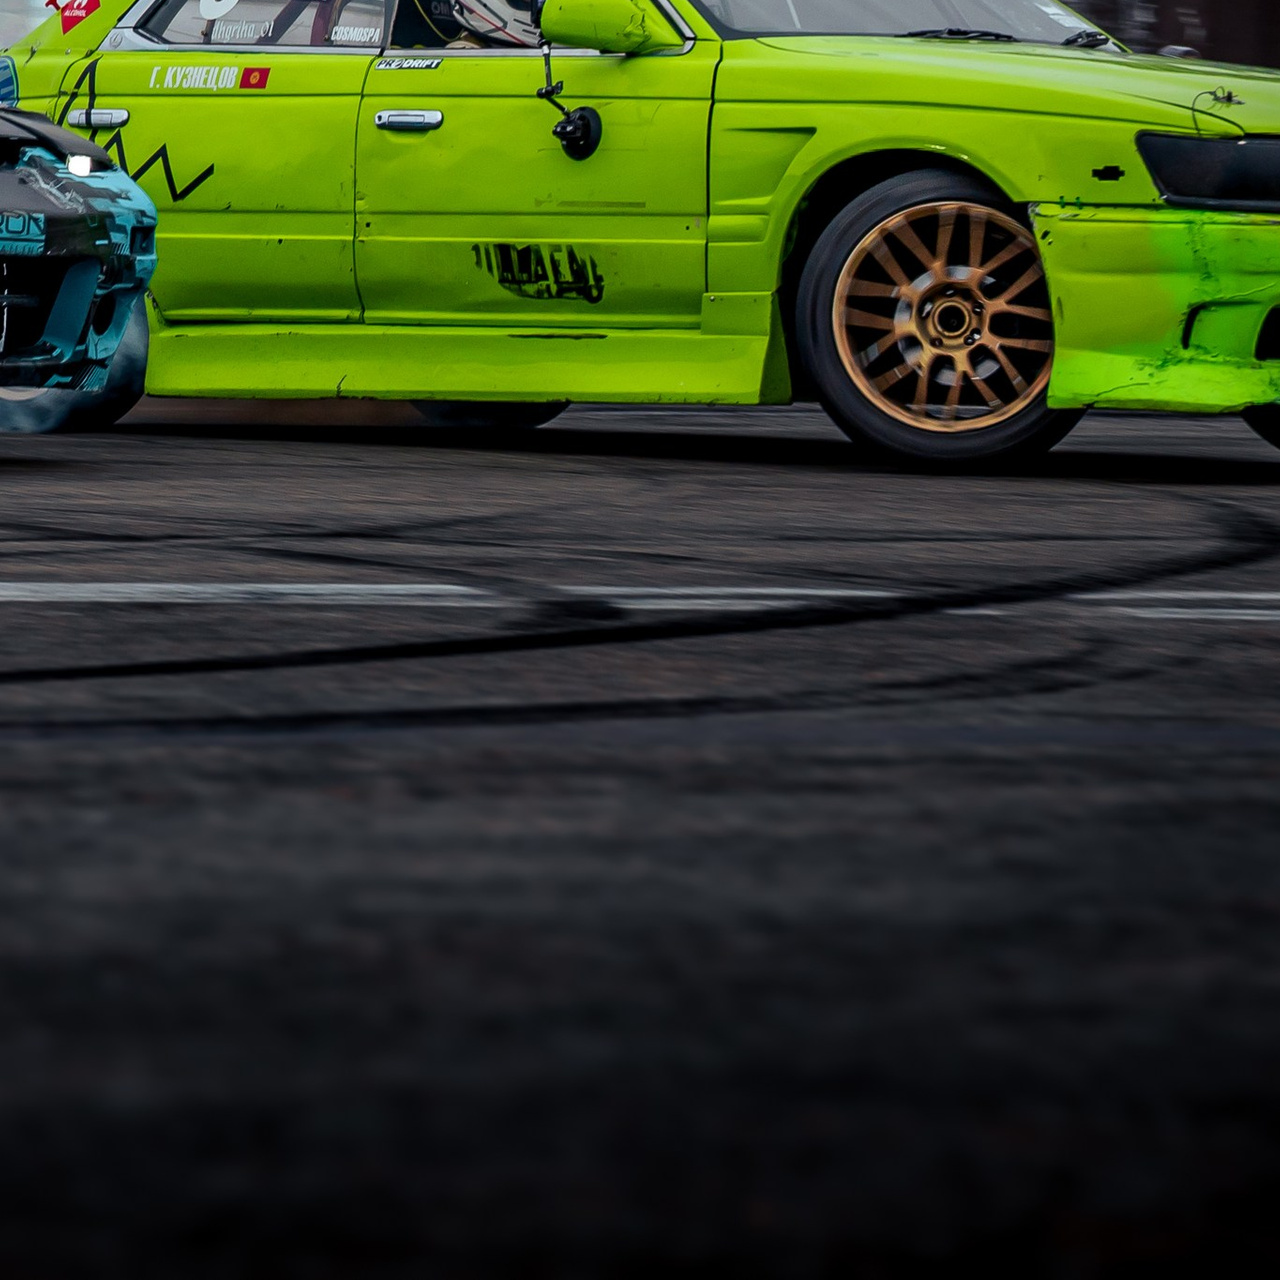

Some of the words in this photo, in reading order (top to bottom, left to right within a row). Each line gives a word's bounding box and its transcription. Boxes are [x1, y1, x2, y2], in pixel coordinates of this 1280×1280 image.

[330, 25, 382, 42] COSMOSPA
[149, 66, 161, 88] Г.
[163, 66, 239, 91] КУЗНЕЦОВ
